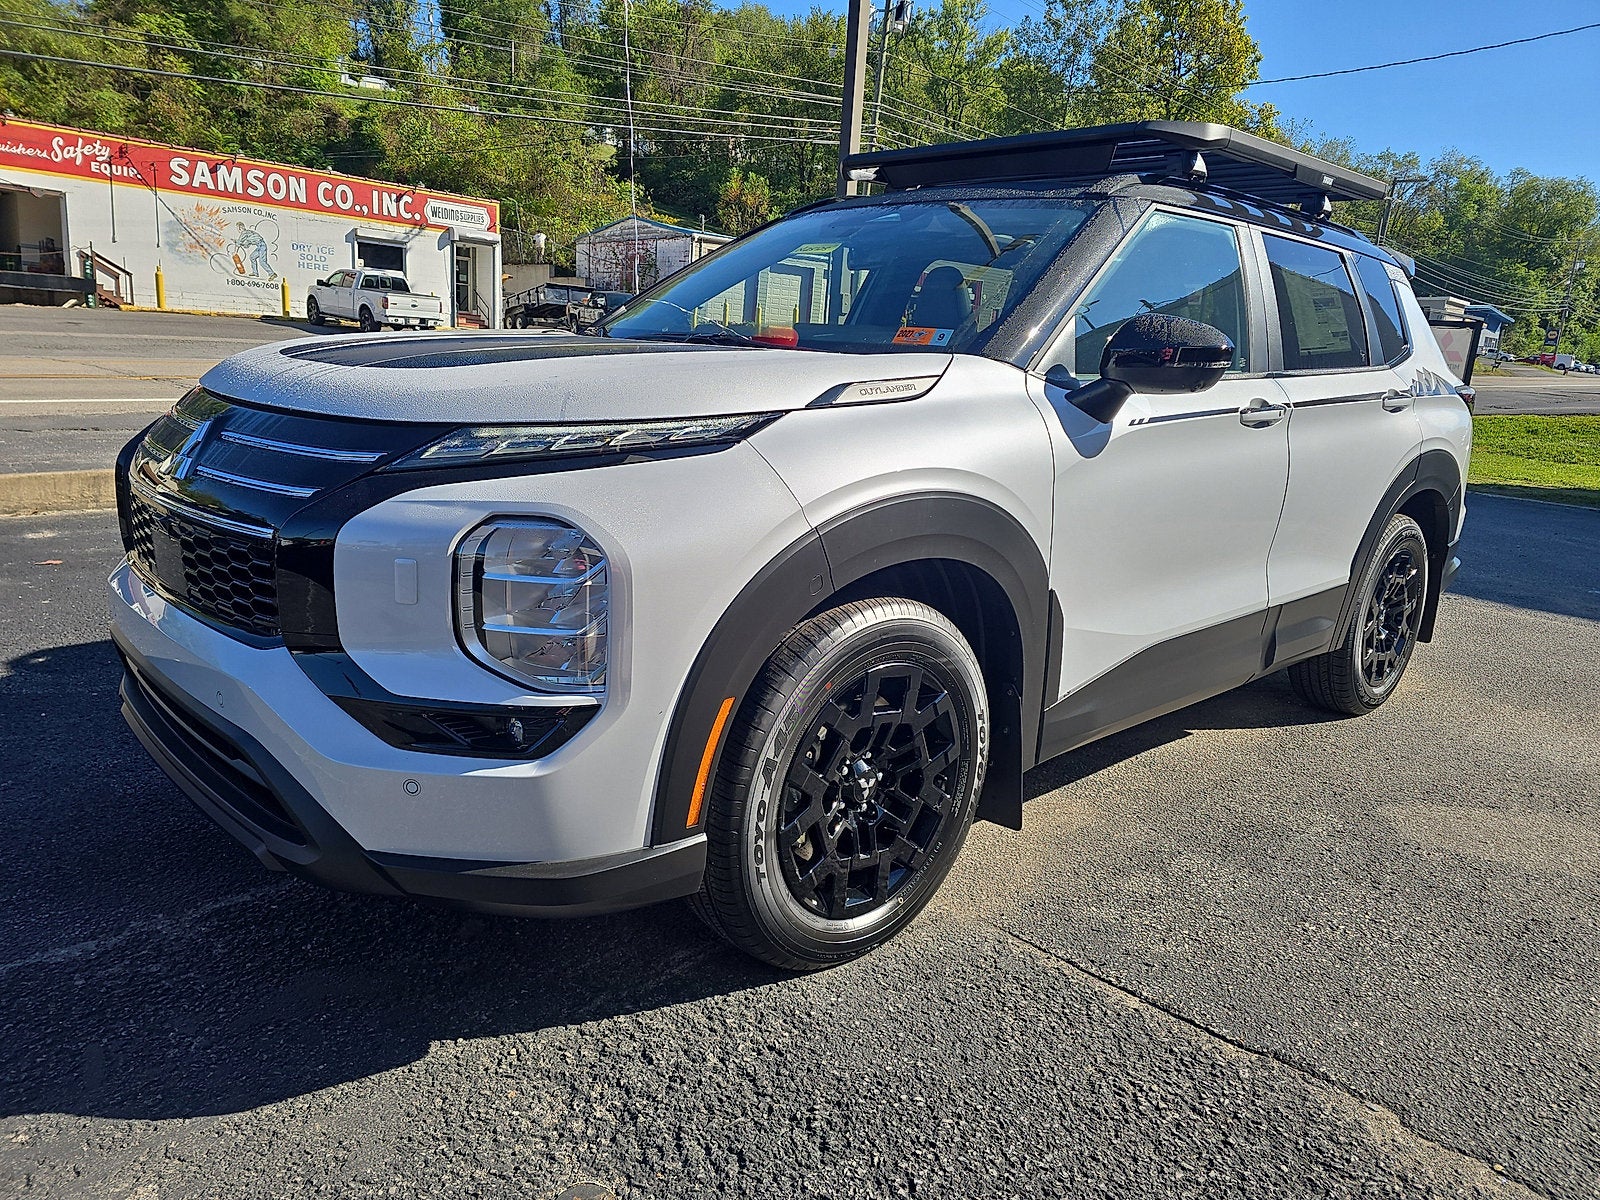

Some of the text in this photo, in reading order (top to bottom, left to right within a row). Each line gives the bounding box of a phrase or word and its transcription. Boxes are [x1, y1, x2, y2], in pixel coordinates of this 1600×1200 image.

[51, 136, 111, 166] Safety
[169, 157, 307, 204] SAMSON
[222, 206, 252, 214] SAMSON
[430, 205, 485, 223] WELDING SUPPLIES
[291, 242, 335, 256] DRY ICE
[299, 253, 327, 263] SOLD
[297, 261, 329, 272] HERE
[937, 332, 946, 341] 9
[859, 383, 917, 397] OUTLANDER
[754, 798, 767, 886] TOYO
